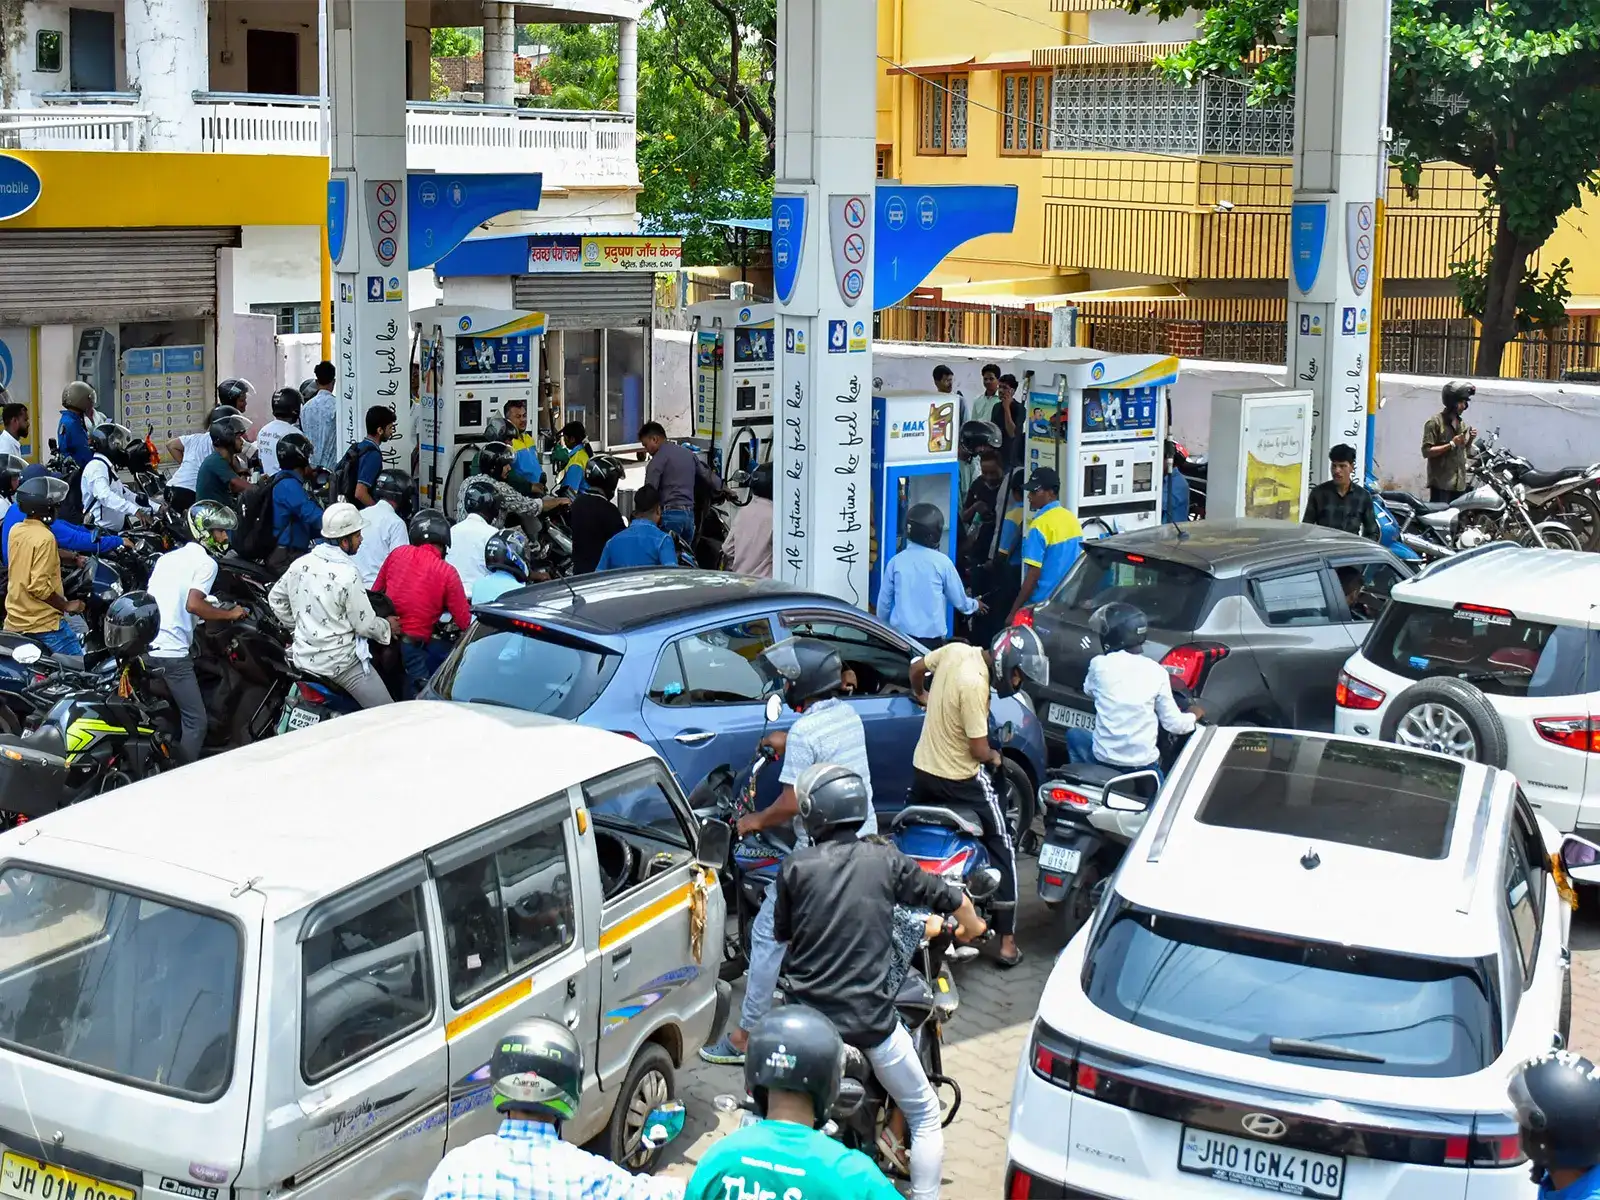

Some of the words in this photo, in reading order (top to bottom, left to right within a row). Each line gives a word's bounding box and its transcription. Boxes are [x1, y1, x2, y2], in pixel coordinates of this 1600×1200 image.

[564, 246, 580, 262] जल
[891, 256, 899, 281] 1
[786, 416, 806, 451] feel
[835, 411, 864, 446] feel
[902, 420, 926, 431] MAK
[786, 459, 804, 480] ko
[834, 454, 860, 475] ko
[786, 544, 804, 570] Ab
[833, 540, 859, 564] Ab
[1198, 1138, 1339, 1188] JH01GN4108
[161, 1178, 206, 1198] Omni
[206, 1188, 218, 1200] E
